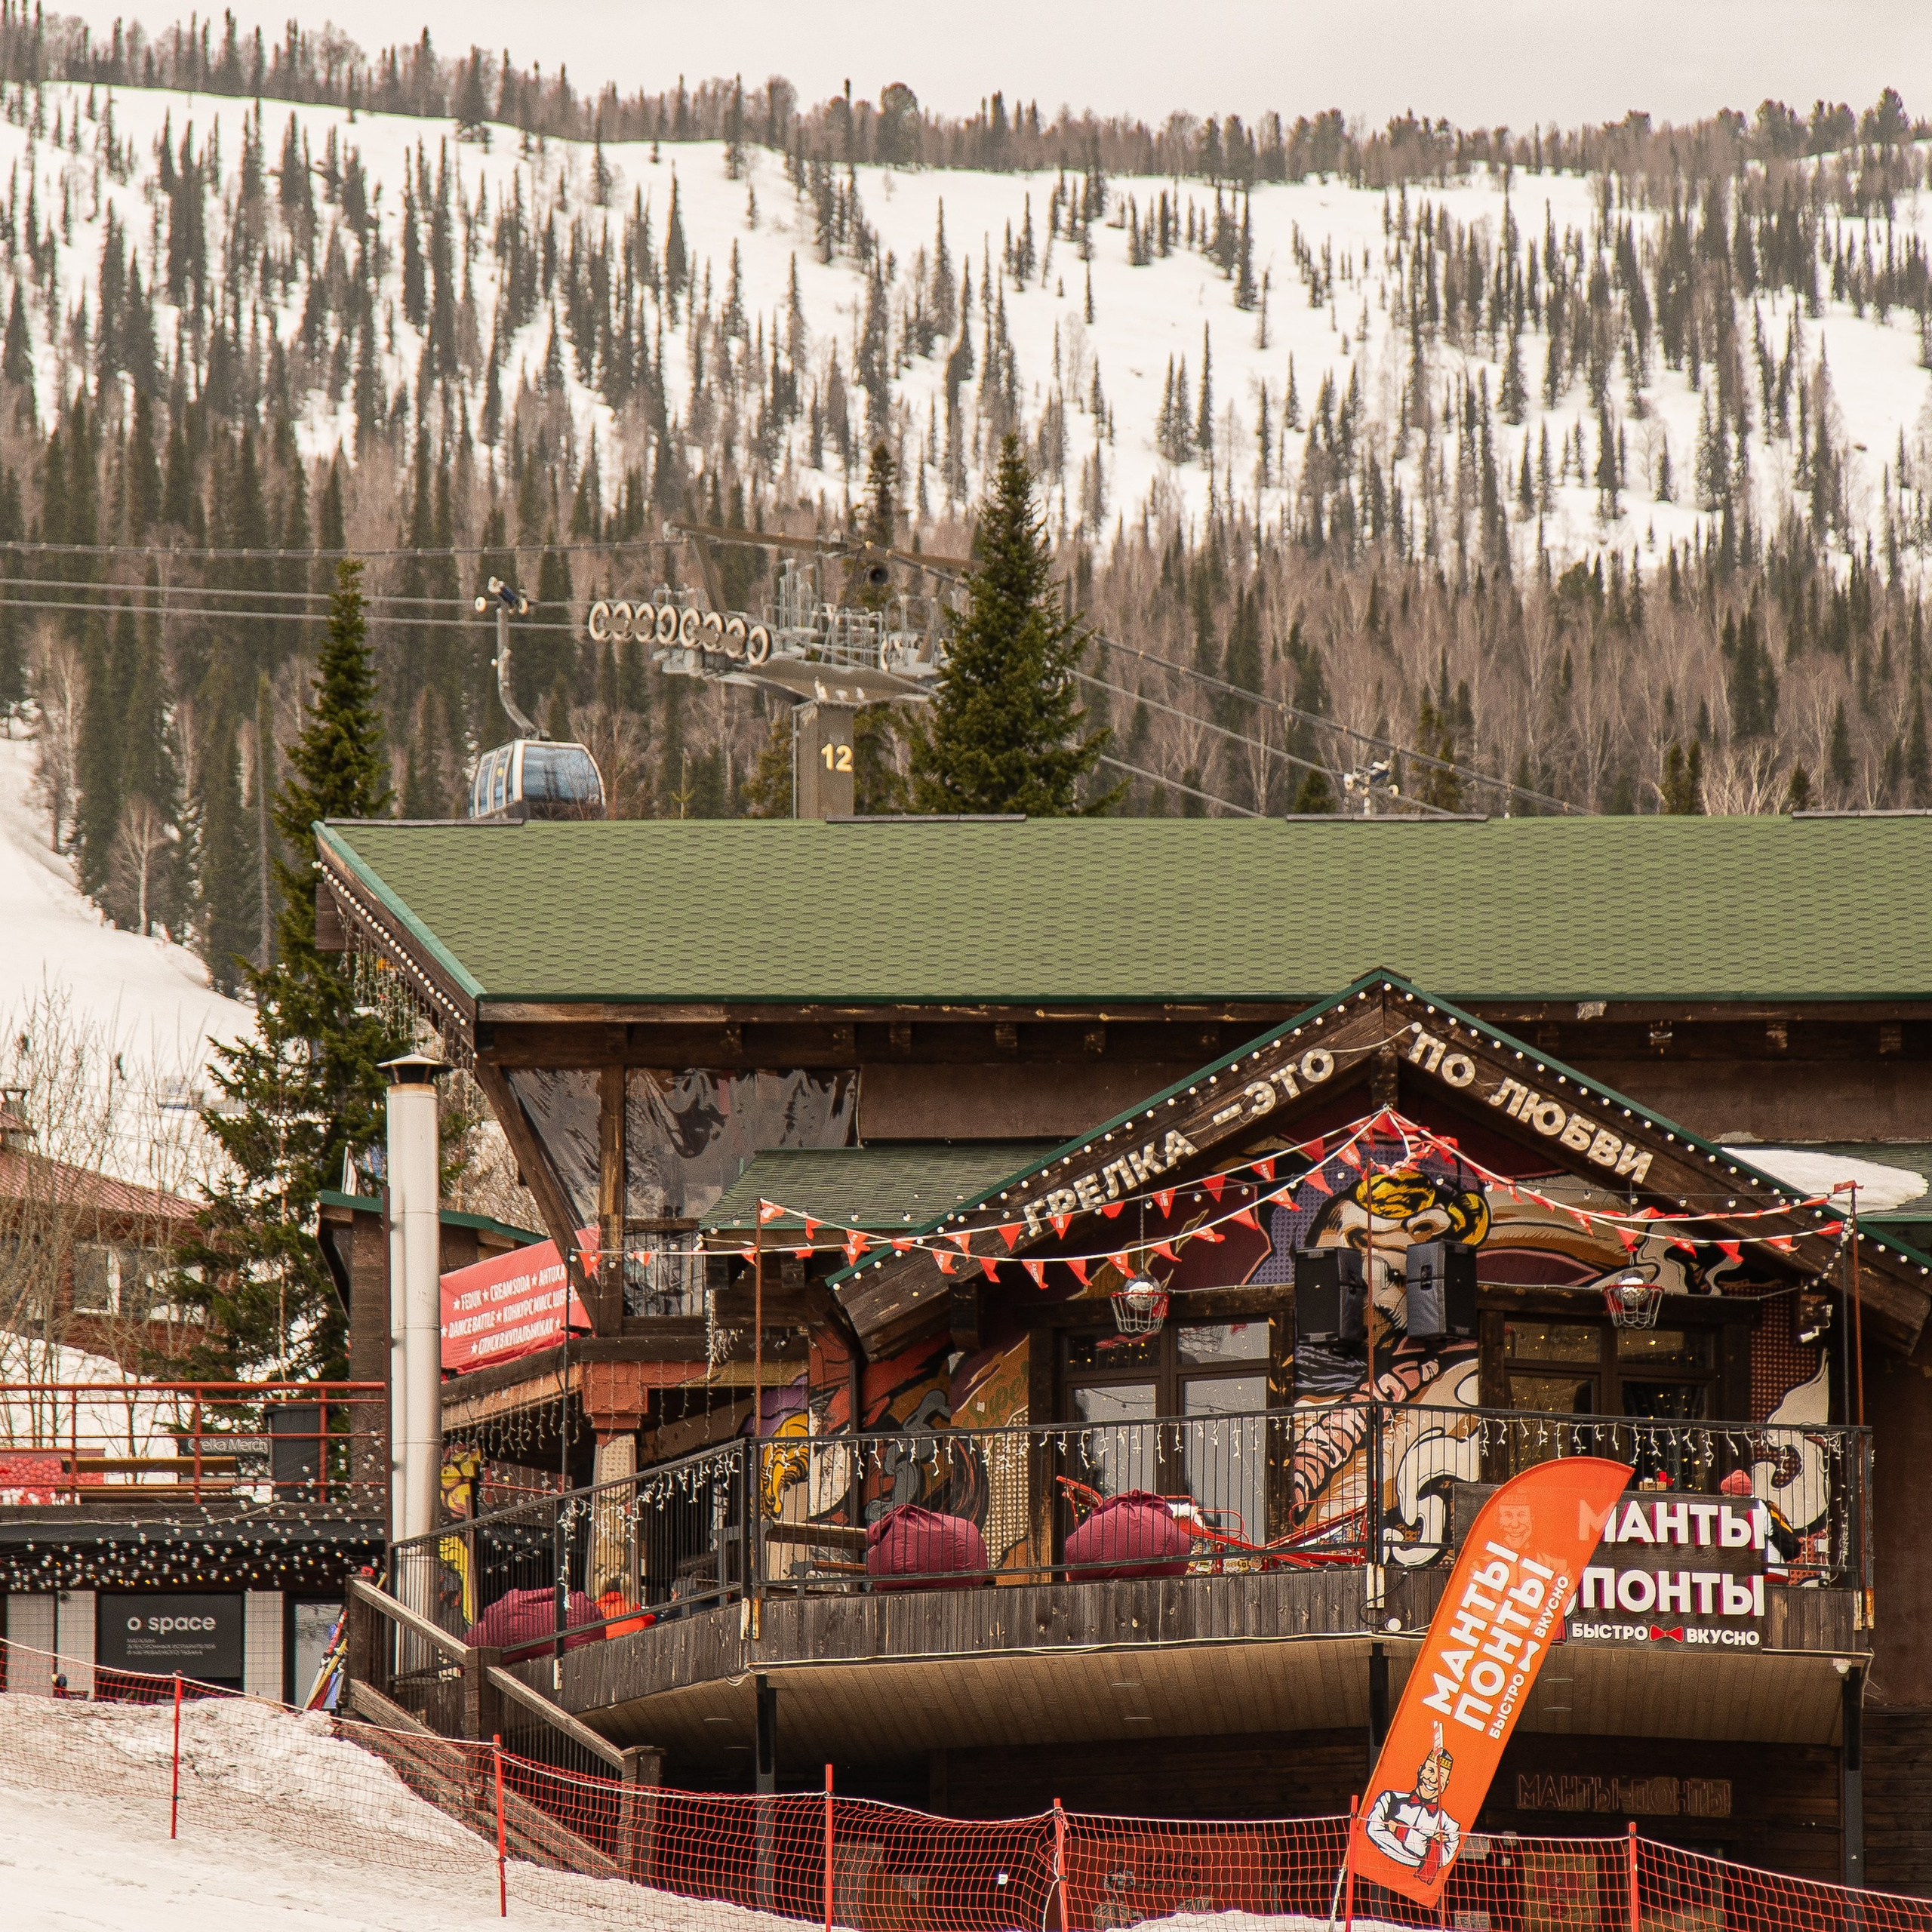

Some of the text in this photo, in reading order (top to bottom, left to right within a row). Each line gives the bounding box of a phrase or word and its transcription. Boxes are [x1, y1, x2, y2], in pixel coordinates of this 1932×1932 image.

[821, 743, 852, 772] 12
[1023, 1130, 1198, 1236] ГРЕЛКА
[1408, 1032, 1475, 1087] ПО
[1489, 1077, 1654, 1183] ЛЮБВИ
[490, 1279, 512, 1303] CREAM
[512, 1274, 531, 1297] SODA
[448, 1317, 472, 1339] DANCE
[472, 1310, 496, 1333] BATTLE
[228, 1438, 269, 1452] Merch
[1578, 1499, 1765, 1550] МАНТЫ
[1581, 1566, 1765, 1617] ПОНТЫ
[127, 1616, 217, 1635] o space
[1423, 1541, 1518, 1717] МАНТЫ
[1452, 1556, 1555, 1733] ПОНТЫ
[1571, 1622, 1760, 1646] БЫСТРО ВКУСНО
[1488, 1575, 1570, 1740] БЫСТРО ВКУСНО
